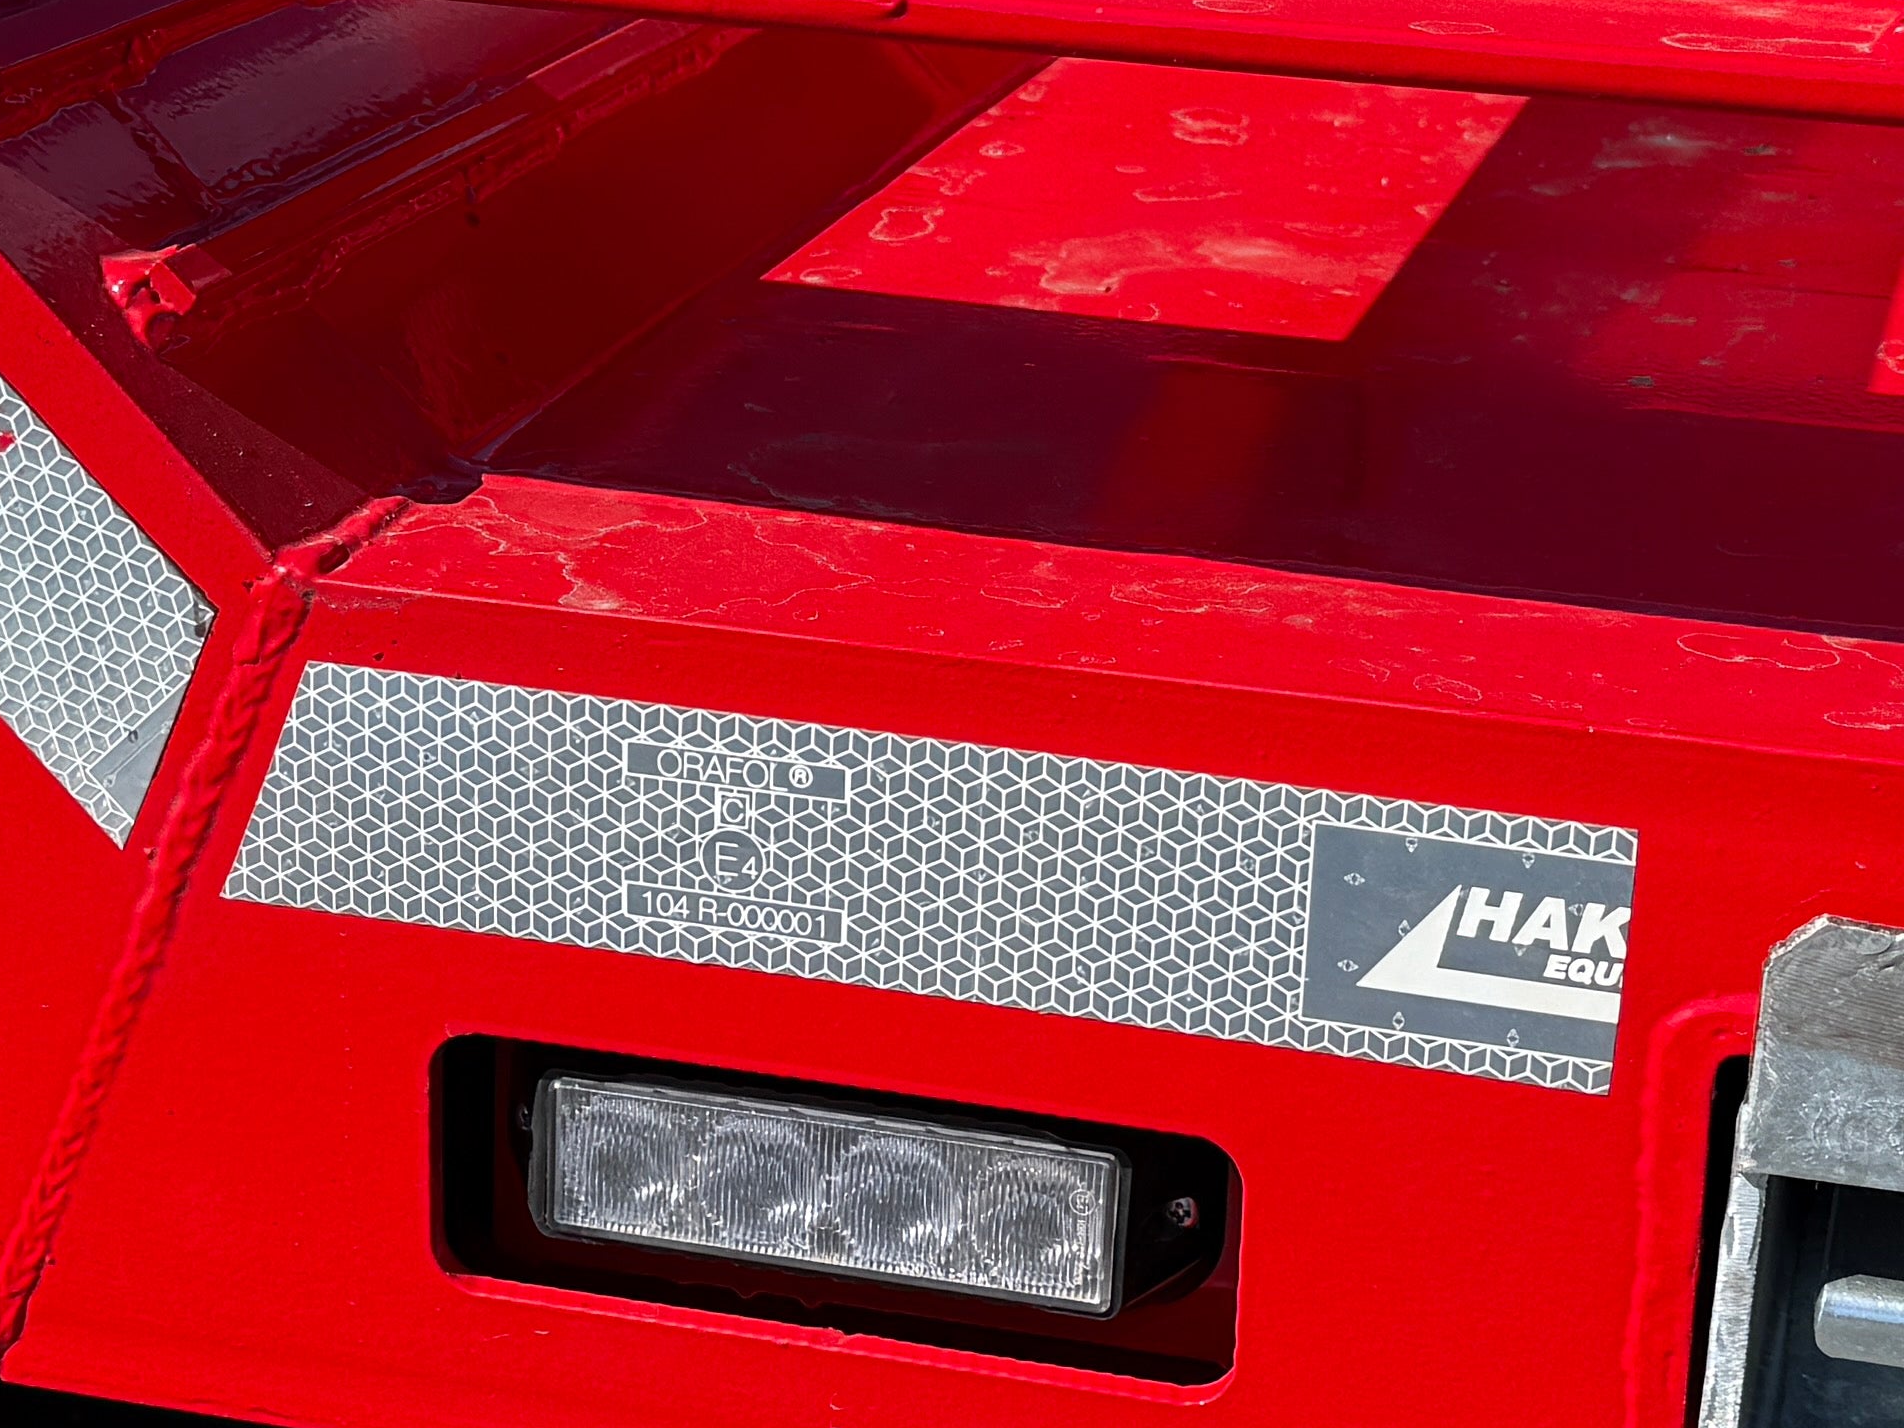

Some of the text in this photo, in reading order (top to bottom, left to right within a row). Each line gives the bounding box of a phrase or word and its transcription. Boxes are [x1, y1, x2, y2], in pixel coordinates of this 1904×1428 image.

[642, 890, 826, 939] 104 R-000001
[1542, 954, 1624, 989] EQU
